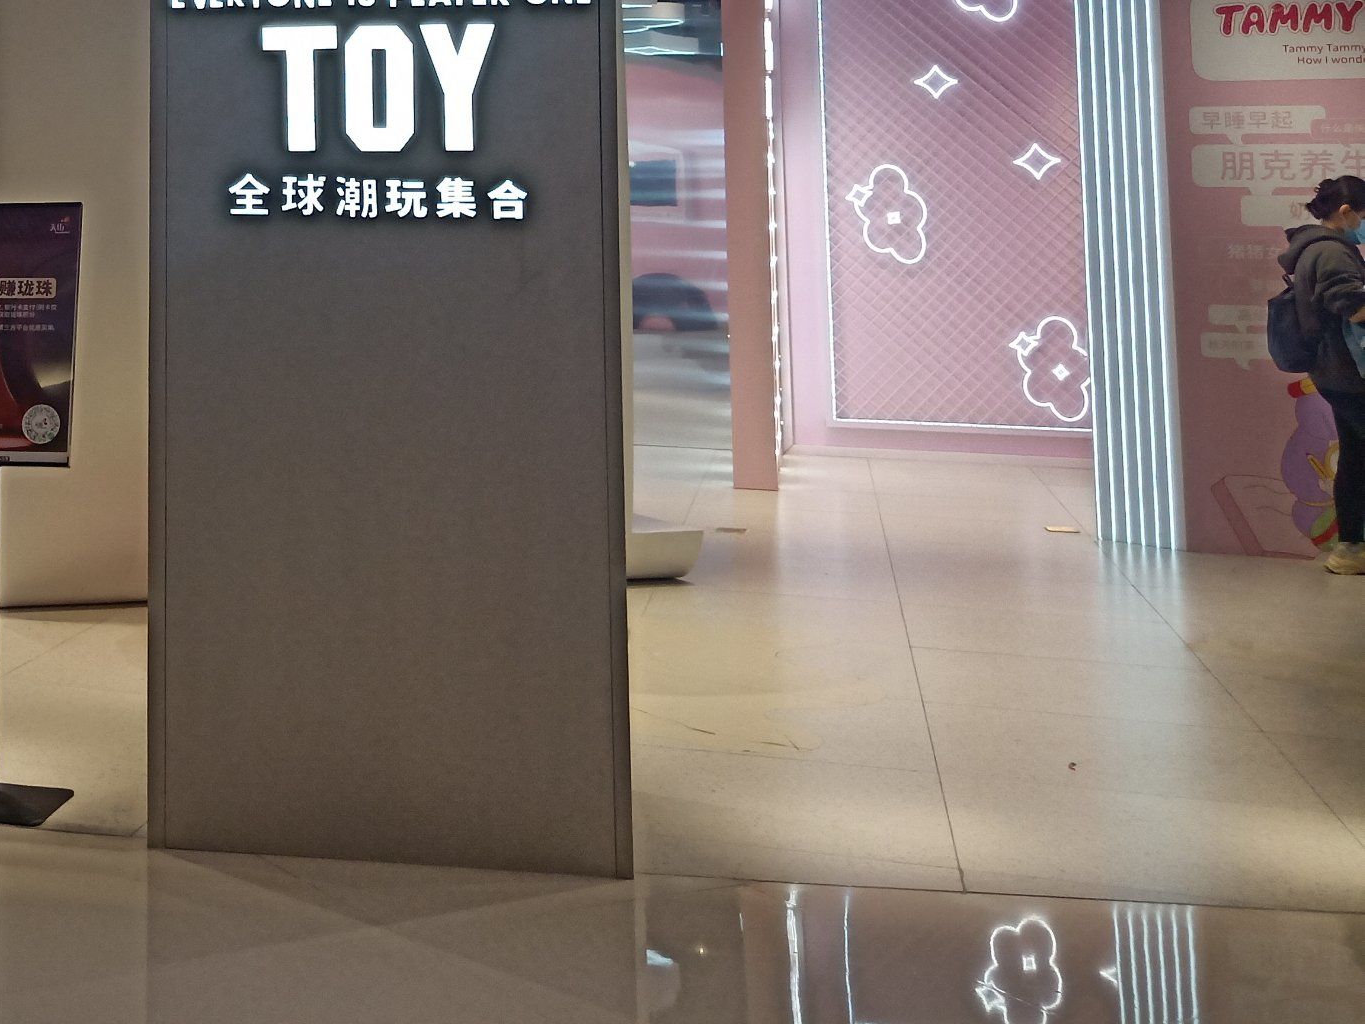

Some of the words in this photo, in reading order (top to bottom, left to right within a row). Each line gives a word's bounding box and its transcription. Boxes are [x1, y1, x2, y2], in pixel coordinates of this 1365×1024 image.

[1214, 0, 1365, 37] TAMMY
[1282, 44, 1324, 55] Tammy
[1297, 56, 1322, 65] How
[1325, 56, 1328, 64] I
[1331, 55, 1365, 64] wond
[261, 23, 496, 153] TOY
[1201, 111, 1294, 130] 早睡早起
[228, 173, 529, 220] 全球潮玩集合
